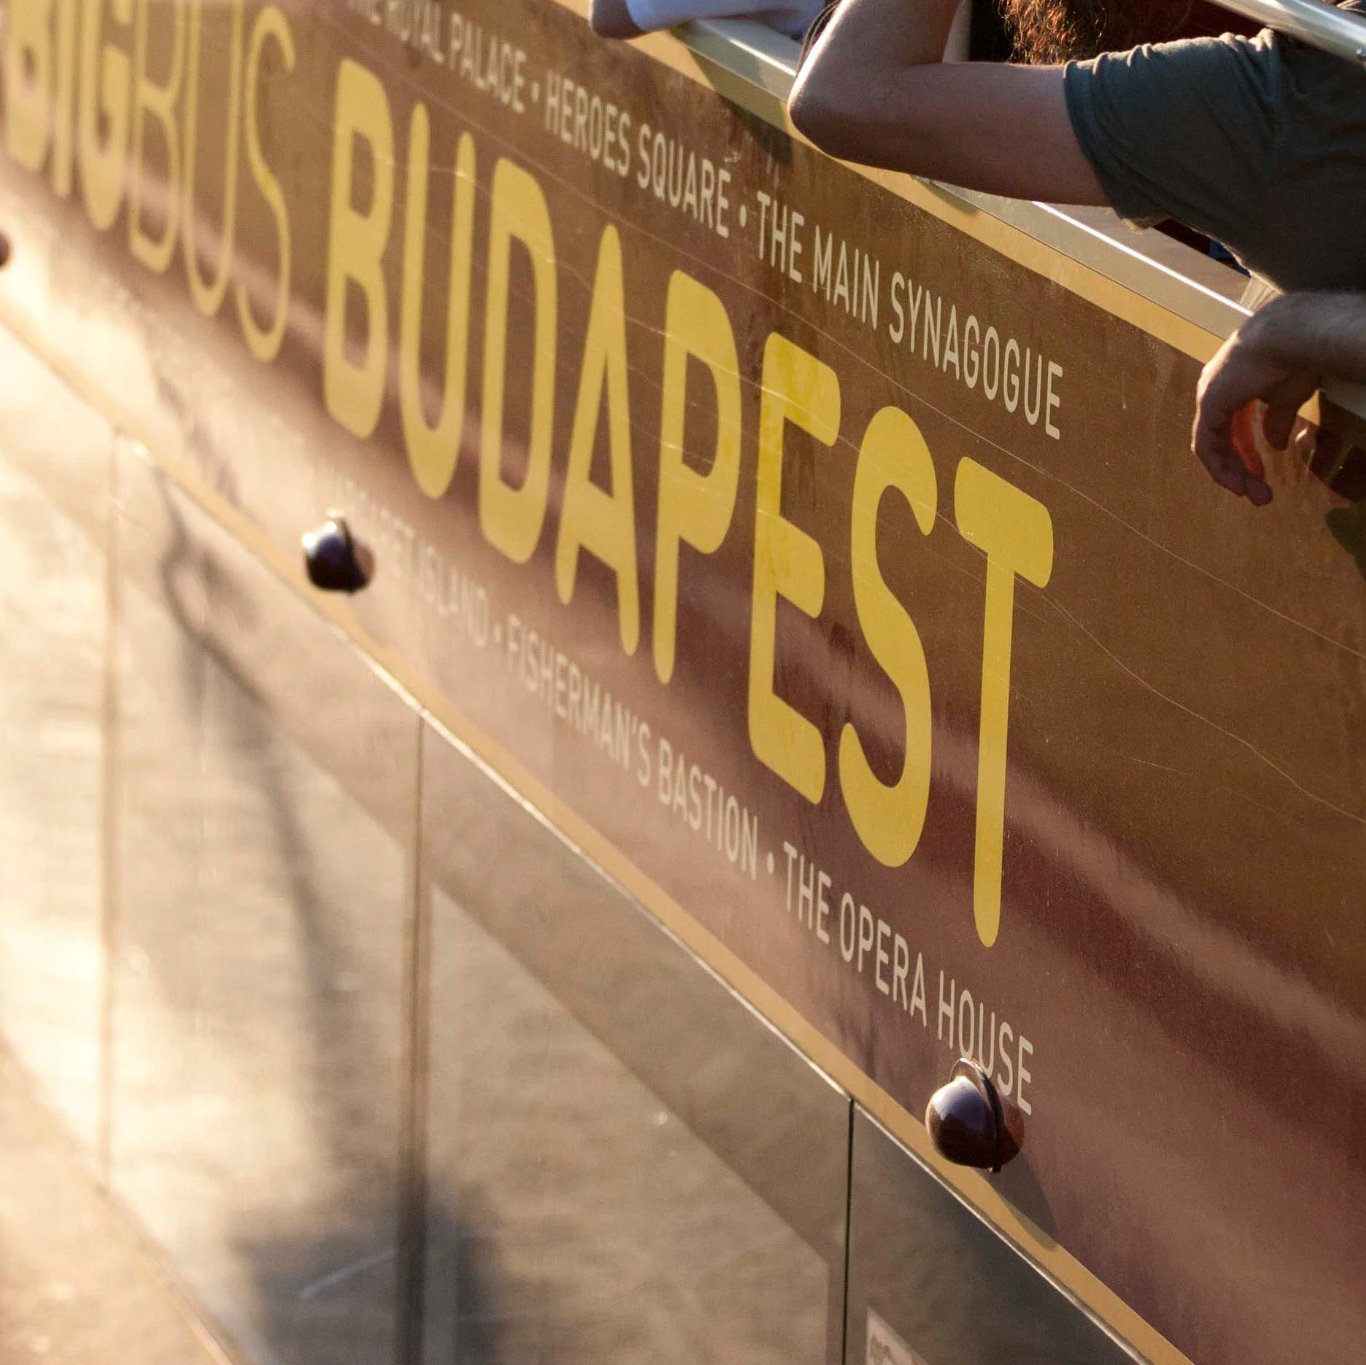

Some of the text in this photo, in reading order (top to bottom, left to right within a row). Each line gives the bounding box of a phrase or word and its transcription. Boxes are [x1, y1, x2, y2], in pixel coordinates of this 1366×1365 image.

[450, 11, 526, 114] PALACE
[543, 71, 632, 179] HEROES
[636, 122, 732, 239] SQUARE
[756, 190, 805, 284] THE
[812, 225, 880, 331] MAIN
[889, 271, 1064, 441] SYNAGOGUE
[323, 55, 1054, 948] BUDAPEST
[507, 613, 652, 789] FISHERMAN'S
[658, 735, 760, 882] BASTION
[783, 841, 833, 946] THE
[839, 891, 929, 1029] OPERA
[937, 968, 1035, 1117] HOUSE
